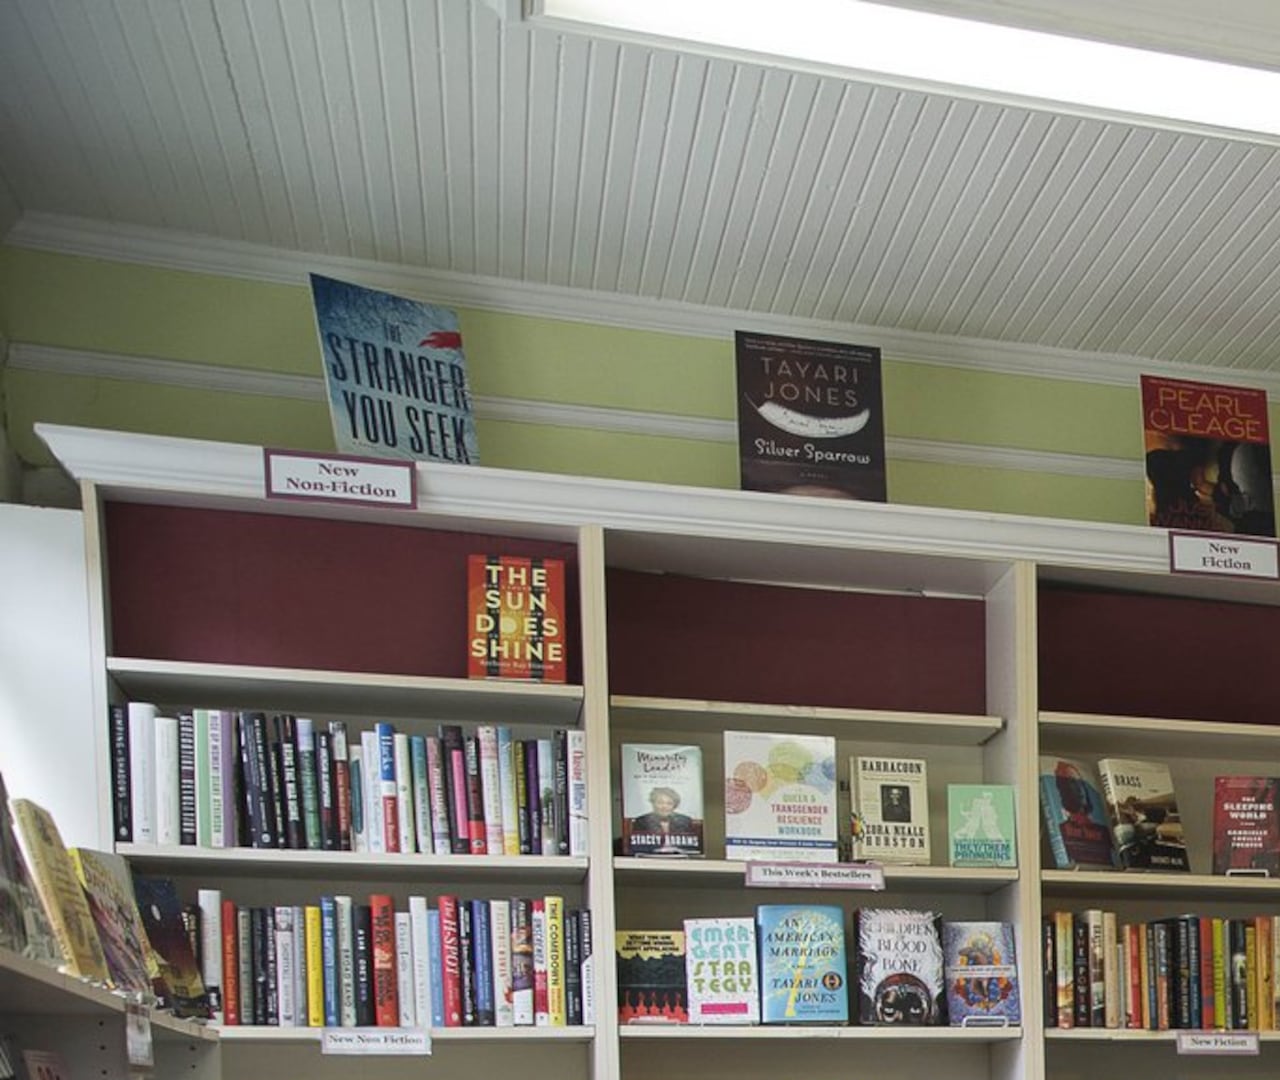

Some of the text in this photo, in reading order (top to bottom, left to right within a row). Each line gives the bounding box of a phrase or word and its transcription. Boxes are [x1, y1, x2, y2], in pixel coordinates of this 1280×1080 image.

[328, 333, 469, 411] STRANGER
[761, 357, 858, 384] TAYARI
[764, 382, 858, 408] JONES
[1159, 386, 1253, 418] PEARL
[342, 390, 470, 465] YOU SEEK
[1150, 406, 1262, 441] CLEAGE
[754, 438, 870, 464] Silver Sparrow
[318, 463, 359, 477] New
[286, 477, 397, 498] Non-Fiction
[1209, 543, 1239, 554] New
[1202, 557, 1251, 570] Fiction
[485, 565, 547, 587] THE
[486, 589, 547, 611] SUN
[476, 614, 558, 637] DOES
[471, 639, 562, 661] SHINE
[861, 761, 923, 773] BARRACOON
[771, 804, 828, 814] TRANSGENDER
[866, 837, 925, 848] HURSTON
[786, 868, 872, 880] Week's Bestsellers
[782, 919, 799, 929] AN
[765, 932, 835, 943] AMERICAN
[878, 940, 926, 953] BLOOD
[772, 979, 818, 989] TAYARI
[795, 993, 837, 1004] JONES
[329, 1035, 422, 1044] New Fiction
[1214, 1037, 1248, 1048] Fiction
